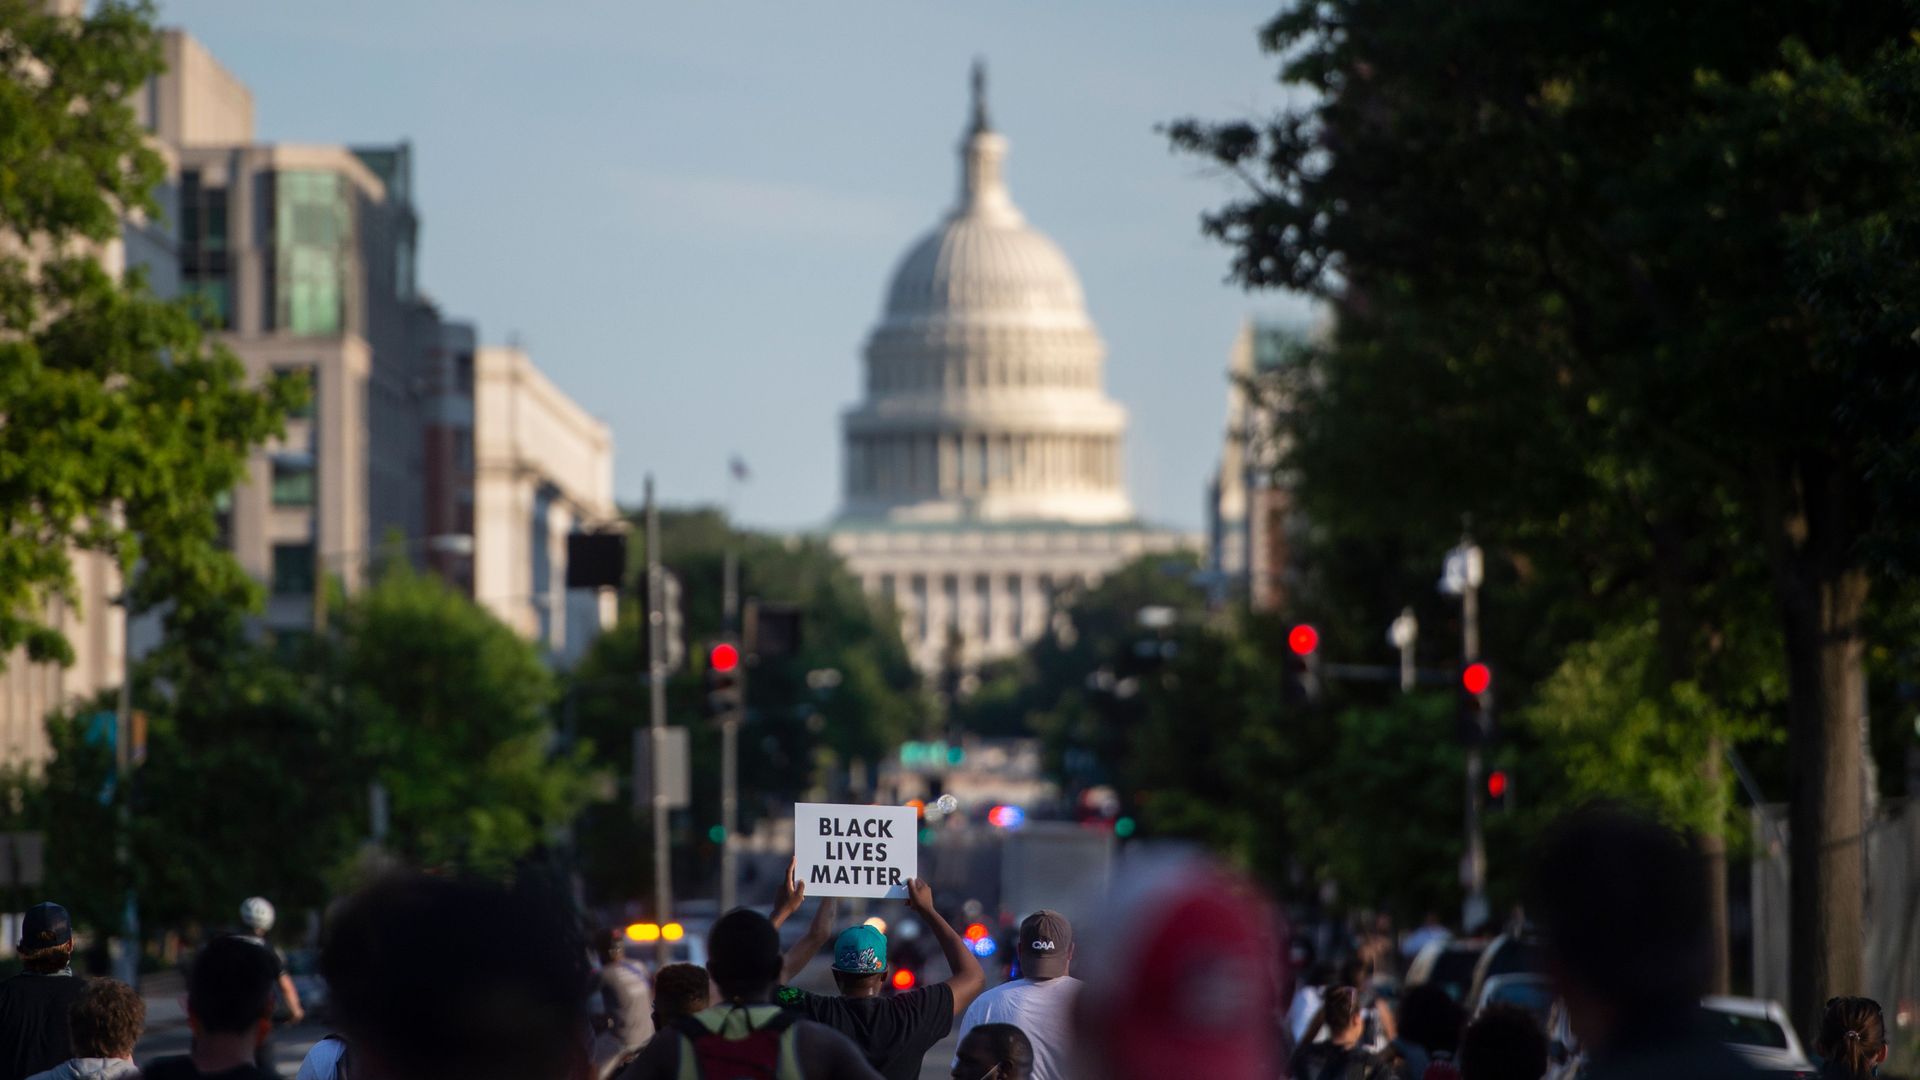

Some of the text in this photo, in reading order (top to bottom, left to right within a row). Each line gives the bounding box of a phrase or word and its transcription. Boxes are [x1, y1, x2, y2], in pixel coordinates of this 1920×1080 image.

[819, 817, 893, 838] BLACK
[826, 841, 887, 861] LIVES
[810, 864, 902, 885] MATTER
